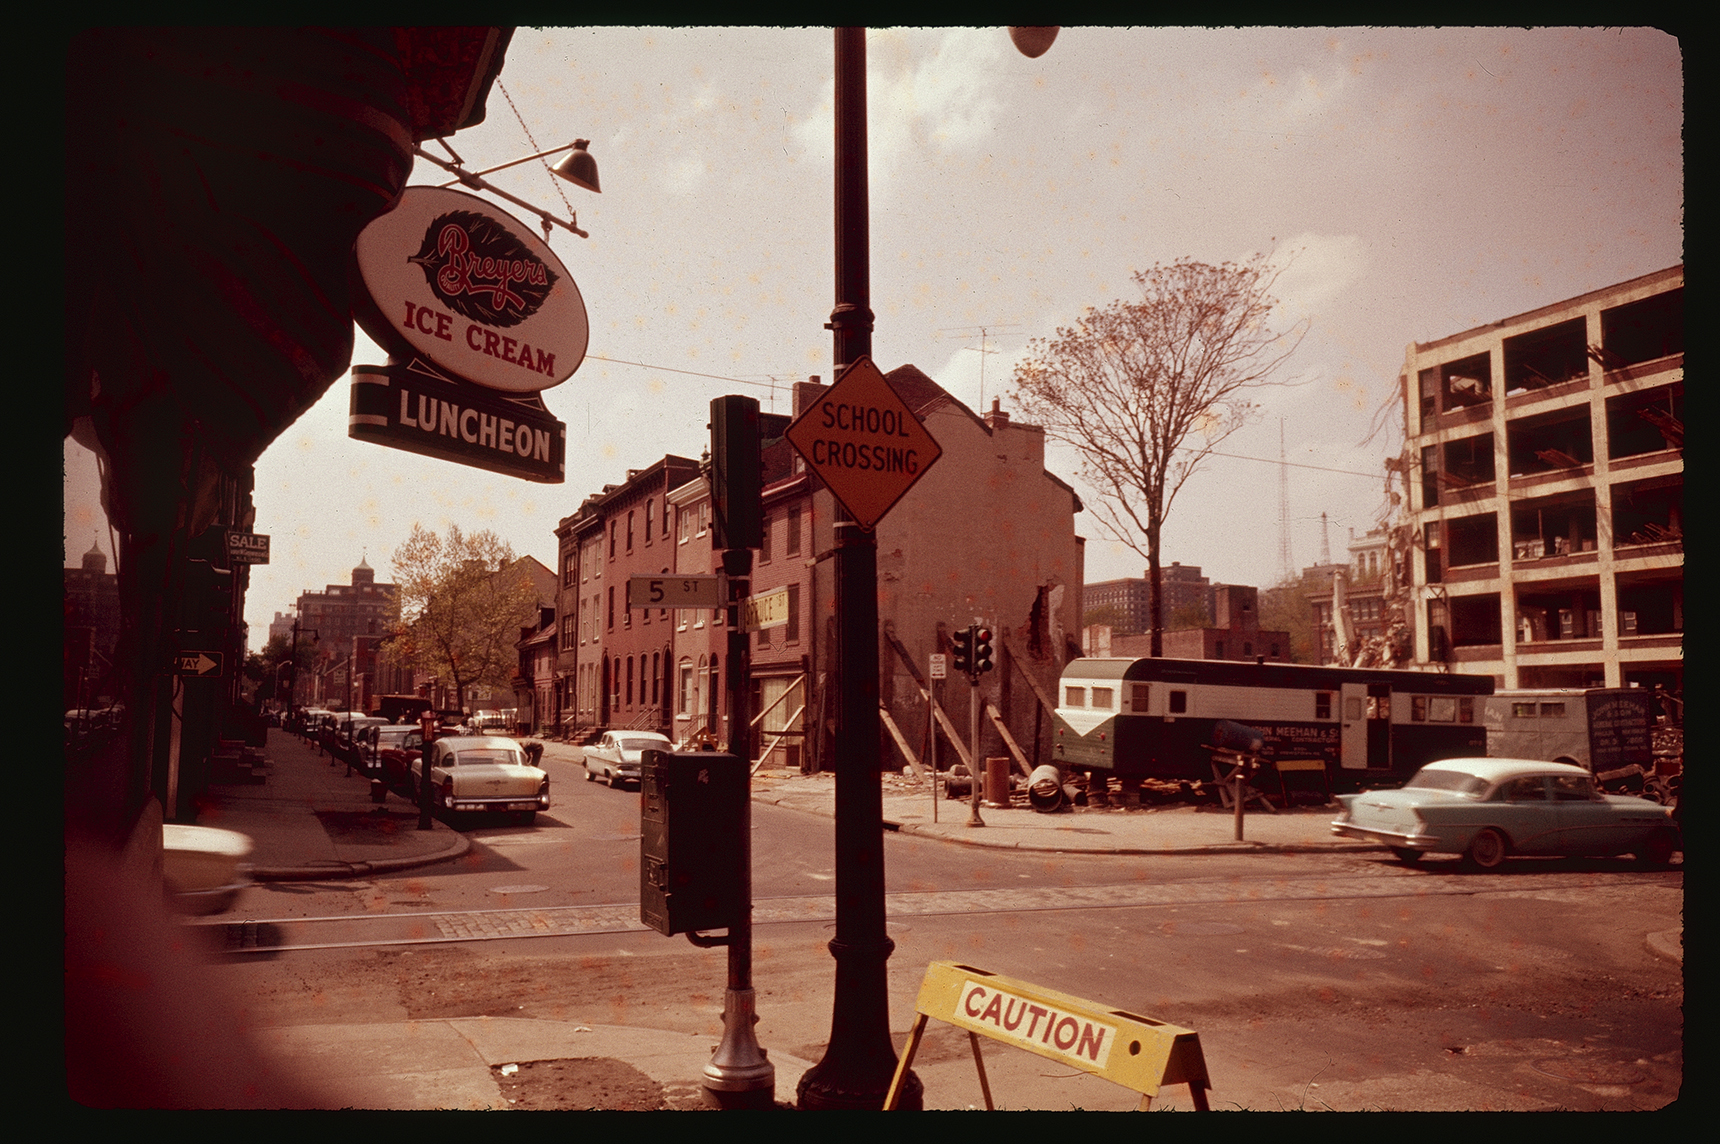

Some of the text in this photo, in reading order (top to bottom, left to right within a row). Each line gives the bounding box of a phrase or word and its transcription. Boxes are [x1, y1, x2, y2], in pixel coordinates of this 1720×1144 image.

[437, 223, 548, 311] Breyers
[440, 274, 461, 291] QUALITY
[403, 300, 556, 378] ICE CREAM
[400, 388, 550, 463] LUNCHEON
[821, 402, 910, 438] SCHOOL
[812, 439, 918, 475] CROSSING
[230, 534, 267, 550] SALE
[650, 581, 698, 602] 5 ST
[1276, 726, 1318, 738] MEEHAN
[964, 987, 1106, 1061] CAUTION
